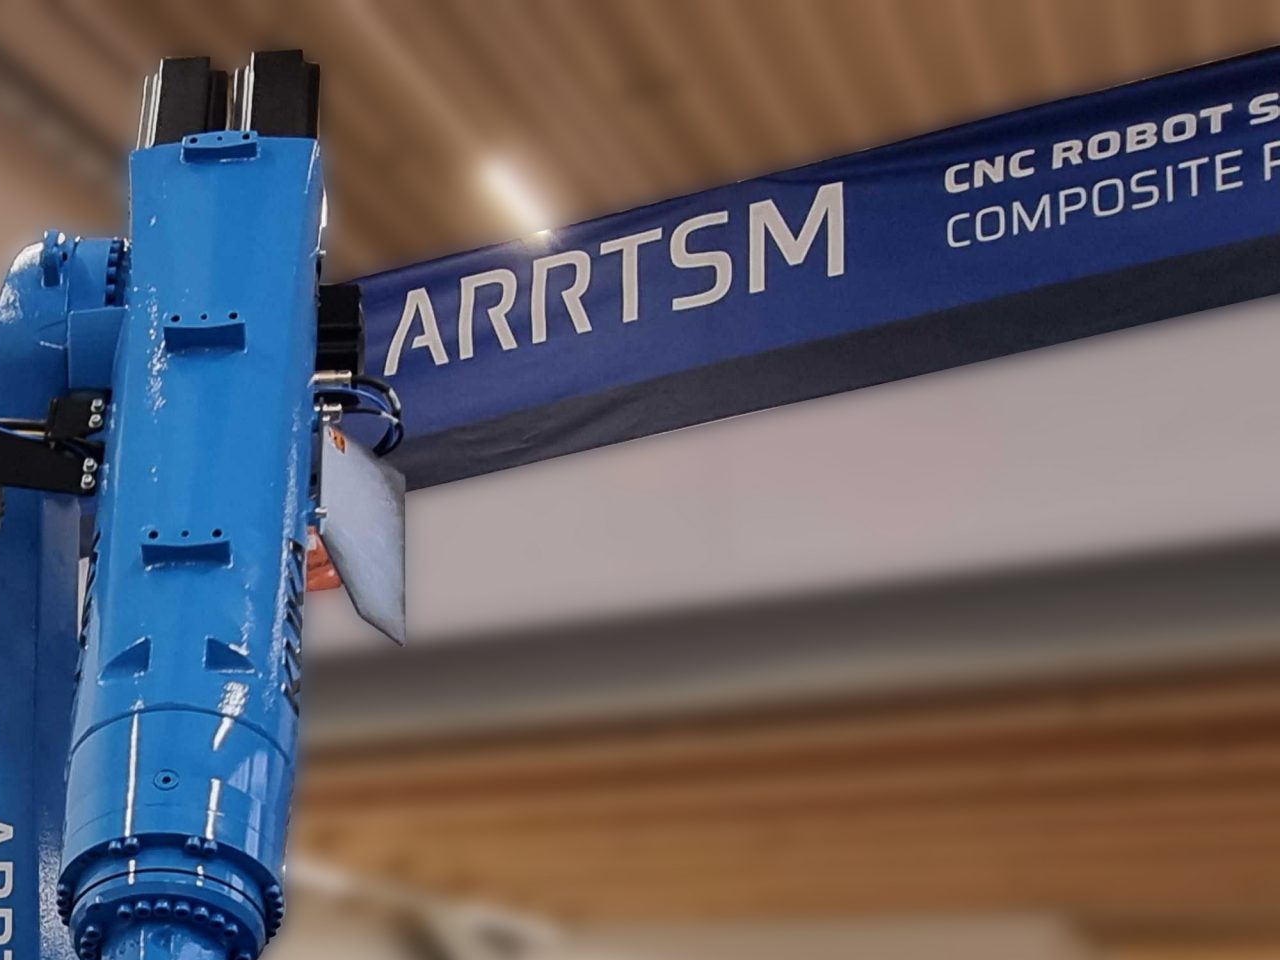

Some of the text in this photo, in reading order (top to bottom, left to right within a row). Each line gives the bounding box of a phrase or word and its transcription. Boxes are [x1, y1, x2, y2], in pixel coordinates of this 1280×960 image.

[944, 149, 1036, 194] CNC
[1051, 103, 1233, 170] ROBOT
[946, 149, 1244, 248] COMPOSITE
[383, 181, 845, 377] ARRTSM
